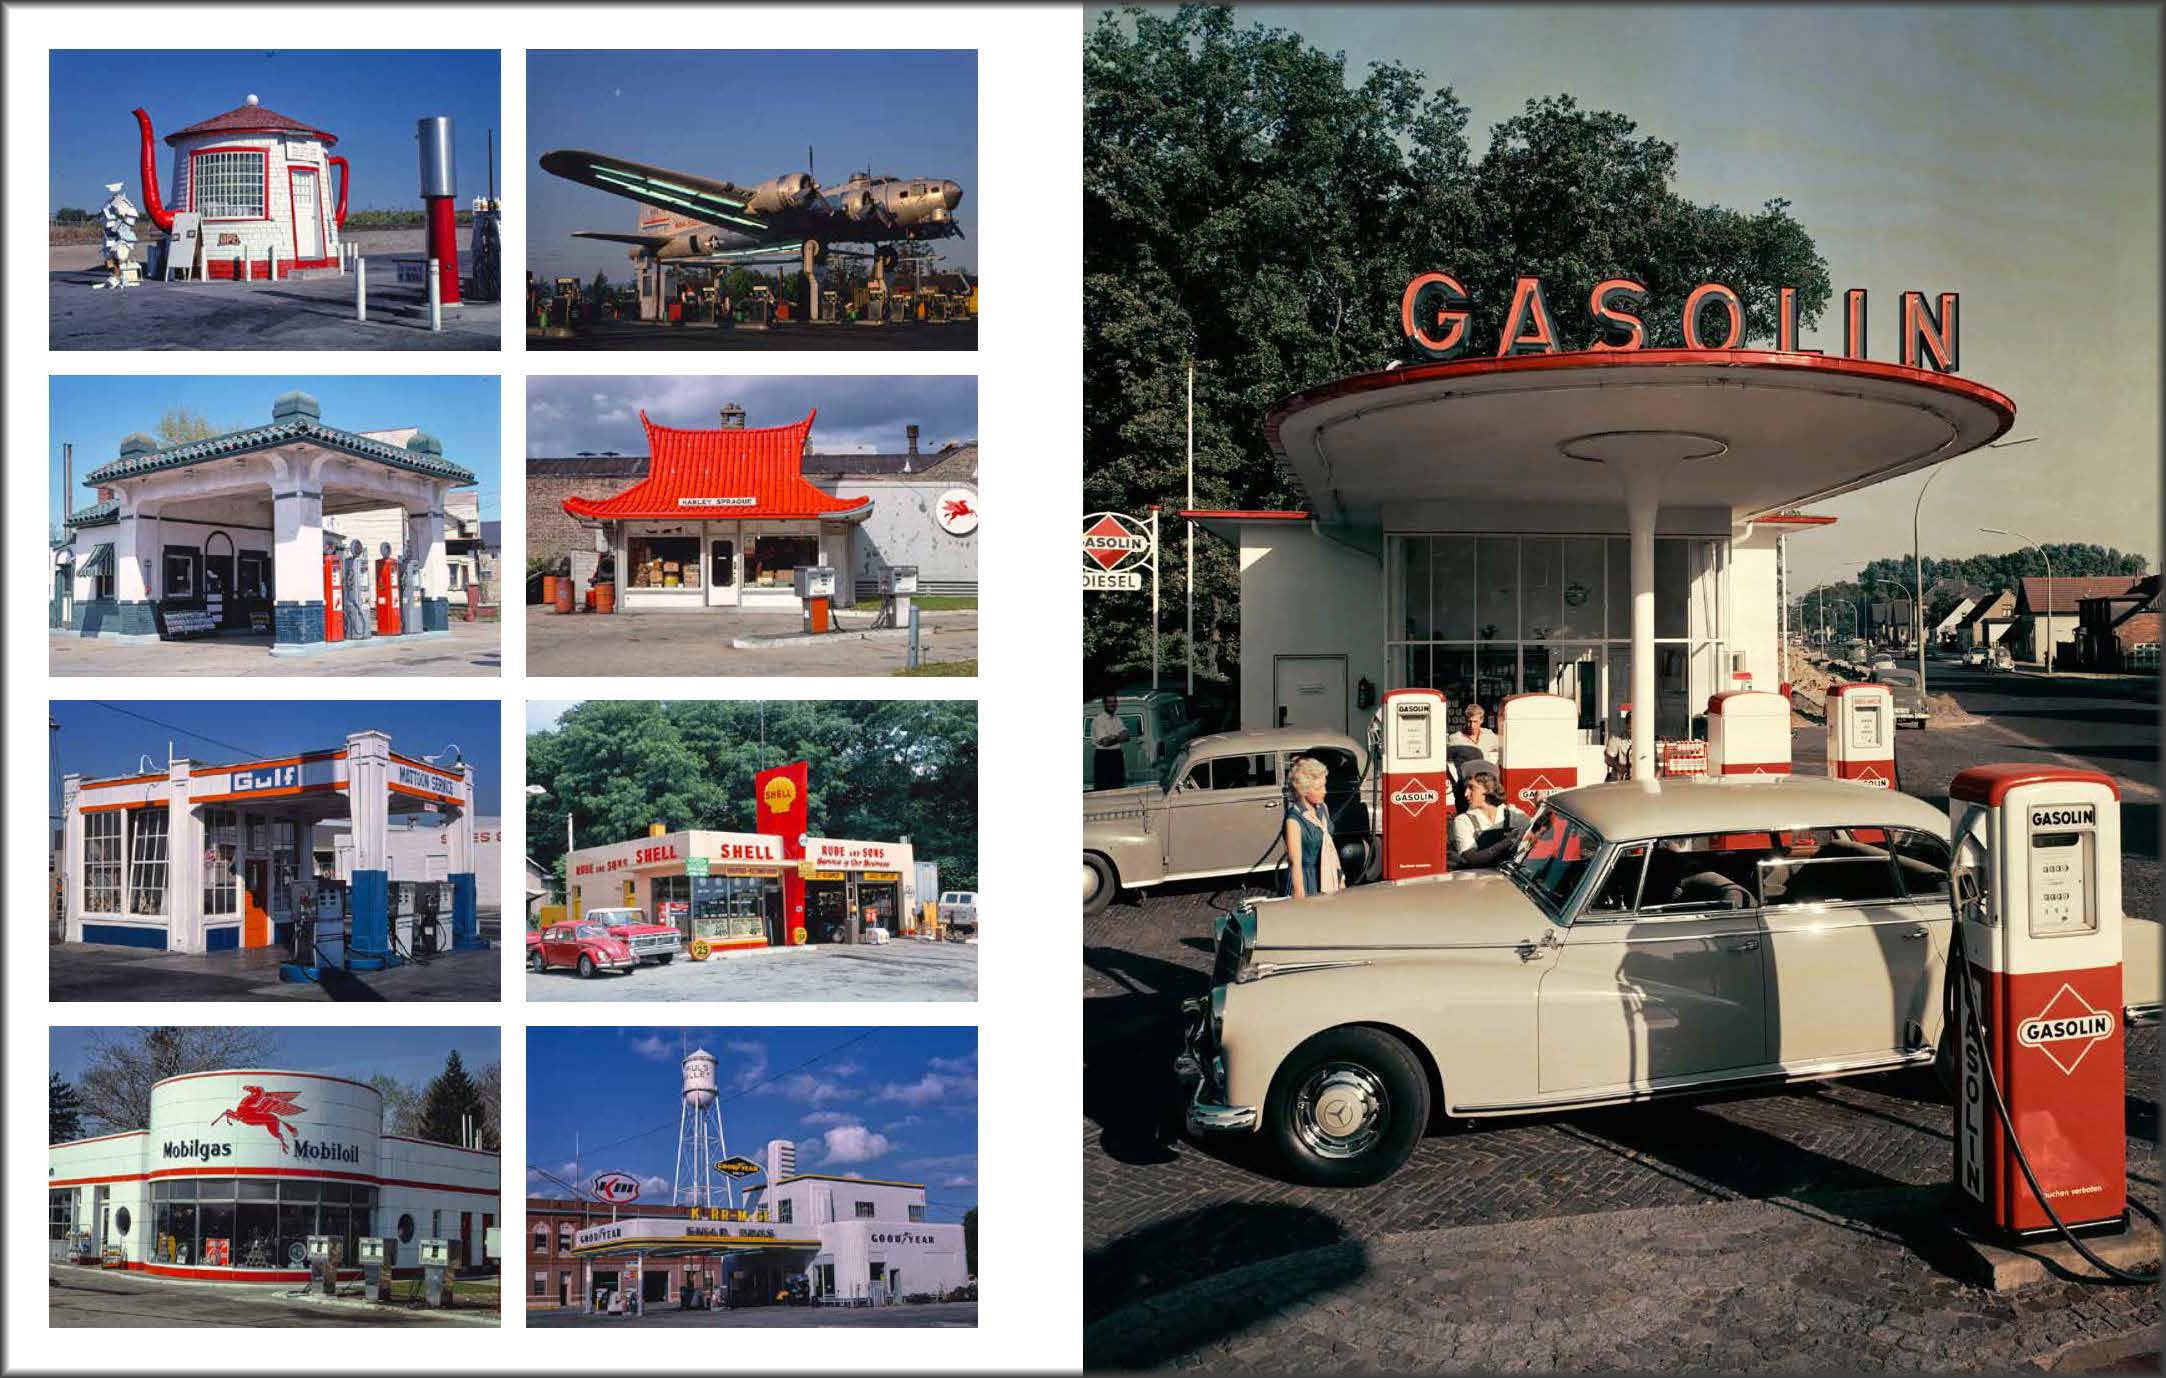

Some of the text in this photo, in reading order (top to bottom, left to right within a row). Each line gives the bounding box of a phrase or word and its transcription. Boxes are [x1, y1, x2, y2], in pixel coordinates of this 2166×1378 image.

[1402, 271, 1960, 373] GASOLIN
[1083, 537, 1142, 549] ASOLIN
[1399, 705, 1430, 713] GASOLIN
[234, 766, 296, 791] Gulf
[399, 765, 454, 797] MATTOON SERVICE
[765, 788, 792, 800] SHELL
[1395, 793, 1435, 803] GASOLIN
[2032, 810, 2093, 827] GASOLIN
[635, 844, 677, 864] SHELL
[720, 843, 774, 861] SHELL
[821, 845, 845, 857] RUDE
[862, 847, 885, 858] SONS
[2027, 1017, 2106, 1040] GASOLIN
[1965, 1004, 1982, 1196] ASOLIN
[163, 1140, 232, 1162] Mobilgas
[294, 1139, 359, 1163] Mobiloil
[2071, 1184, 2103, 1196] verboten
